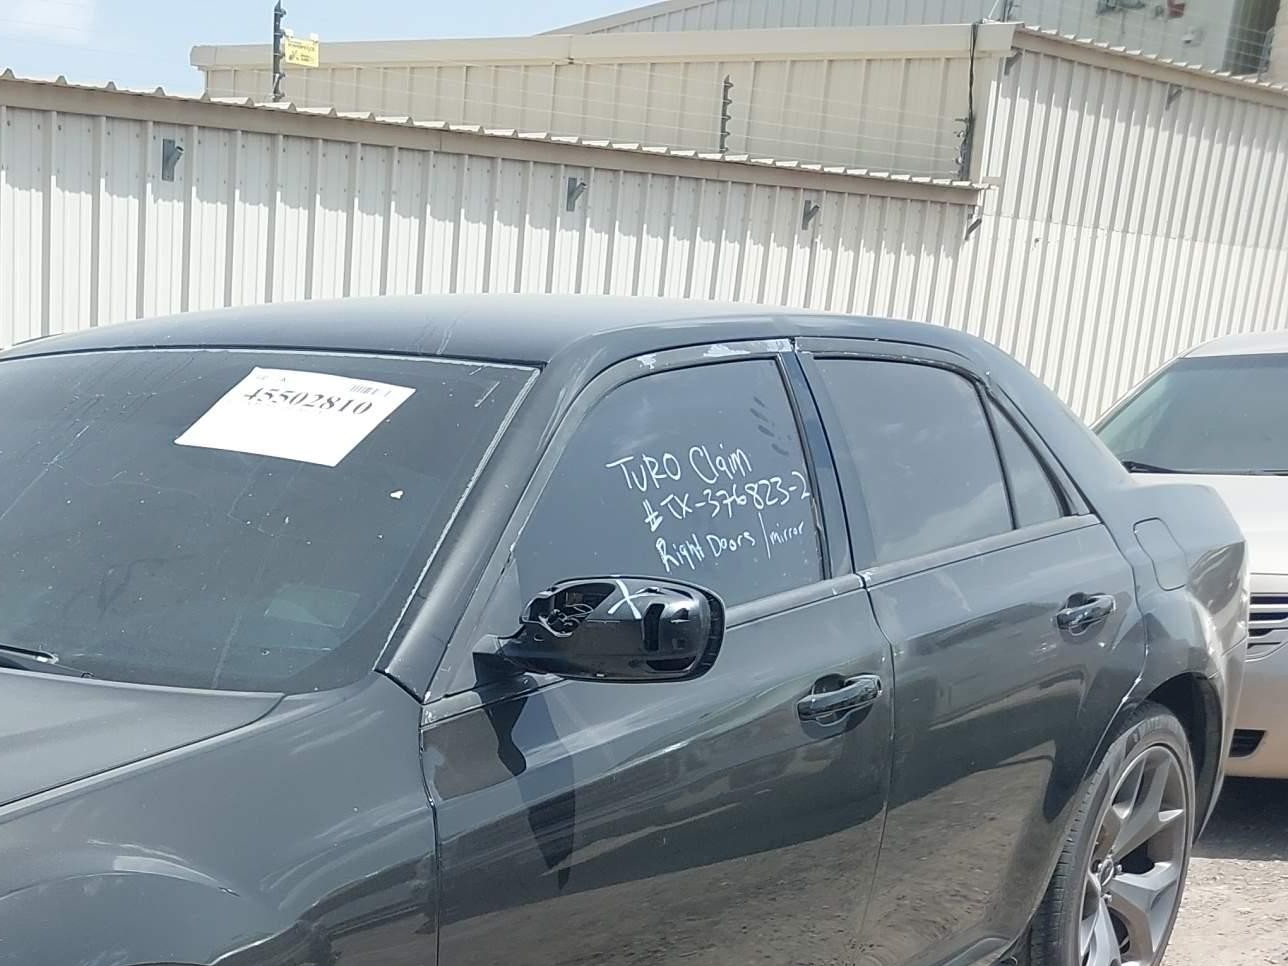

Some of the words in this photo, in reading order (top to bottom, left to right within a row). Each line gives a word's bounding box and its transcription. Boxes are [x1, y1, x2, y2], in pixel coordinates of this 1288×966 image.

[244, 387, 373, 415] 45502810
[689, 443, 752, 484] Claim
[656, 533, 705, 573] Right
[706, 531, 757, 558] Doors
